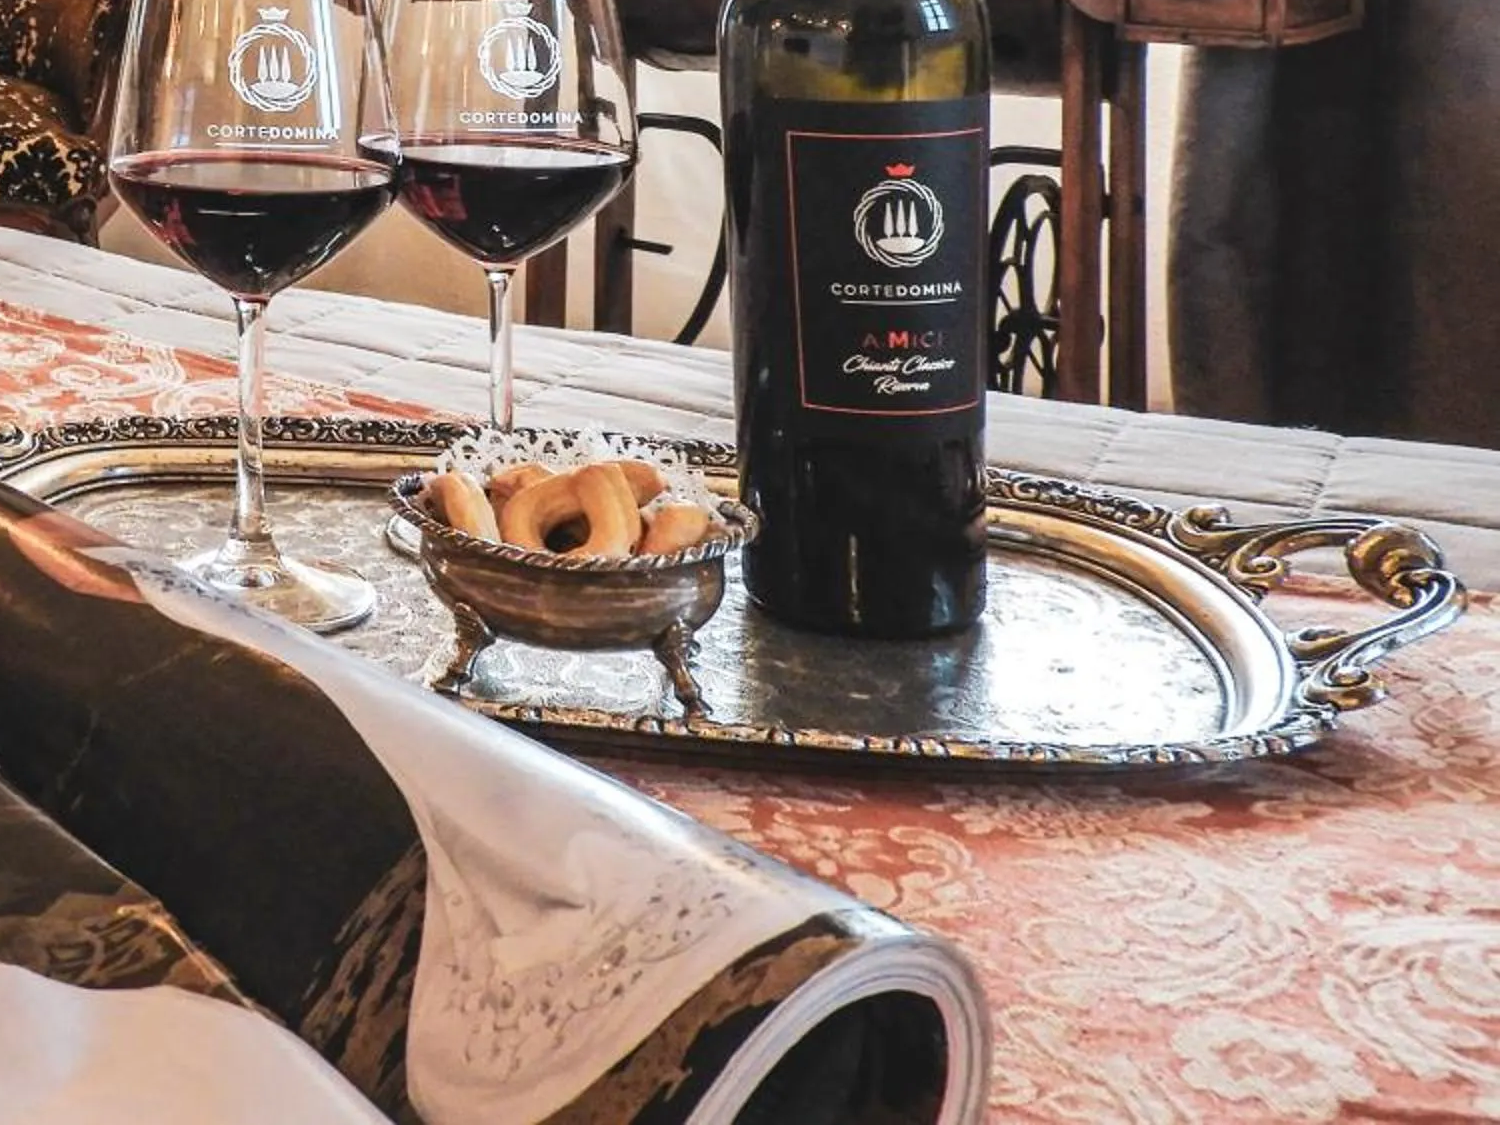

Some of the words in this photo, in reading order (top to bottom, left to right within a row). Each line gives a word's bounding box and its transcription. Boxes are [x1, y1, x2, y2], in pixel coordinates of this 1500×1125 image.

[459, 110, 584, 124] CORTEDOMINA
[207, 124, 339, 140] CORTEDOMINA
[831, 280, 963, 297] CORTEDOMINA
